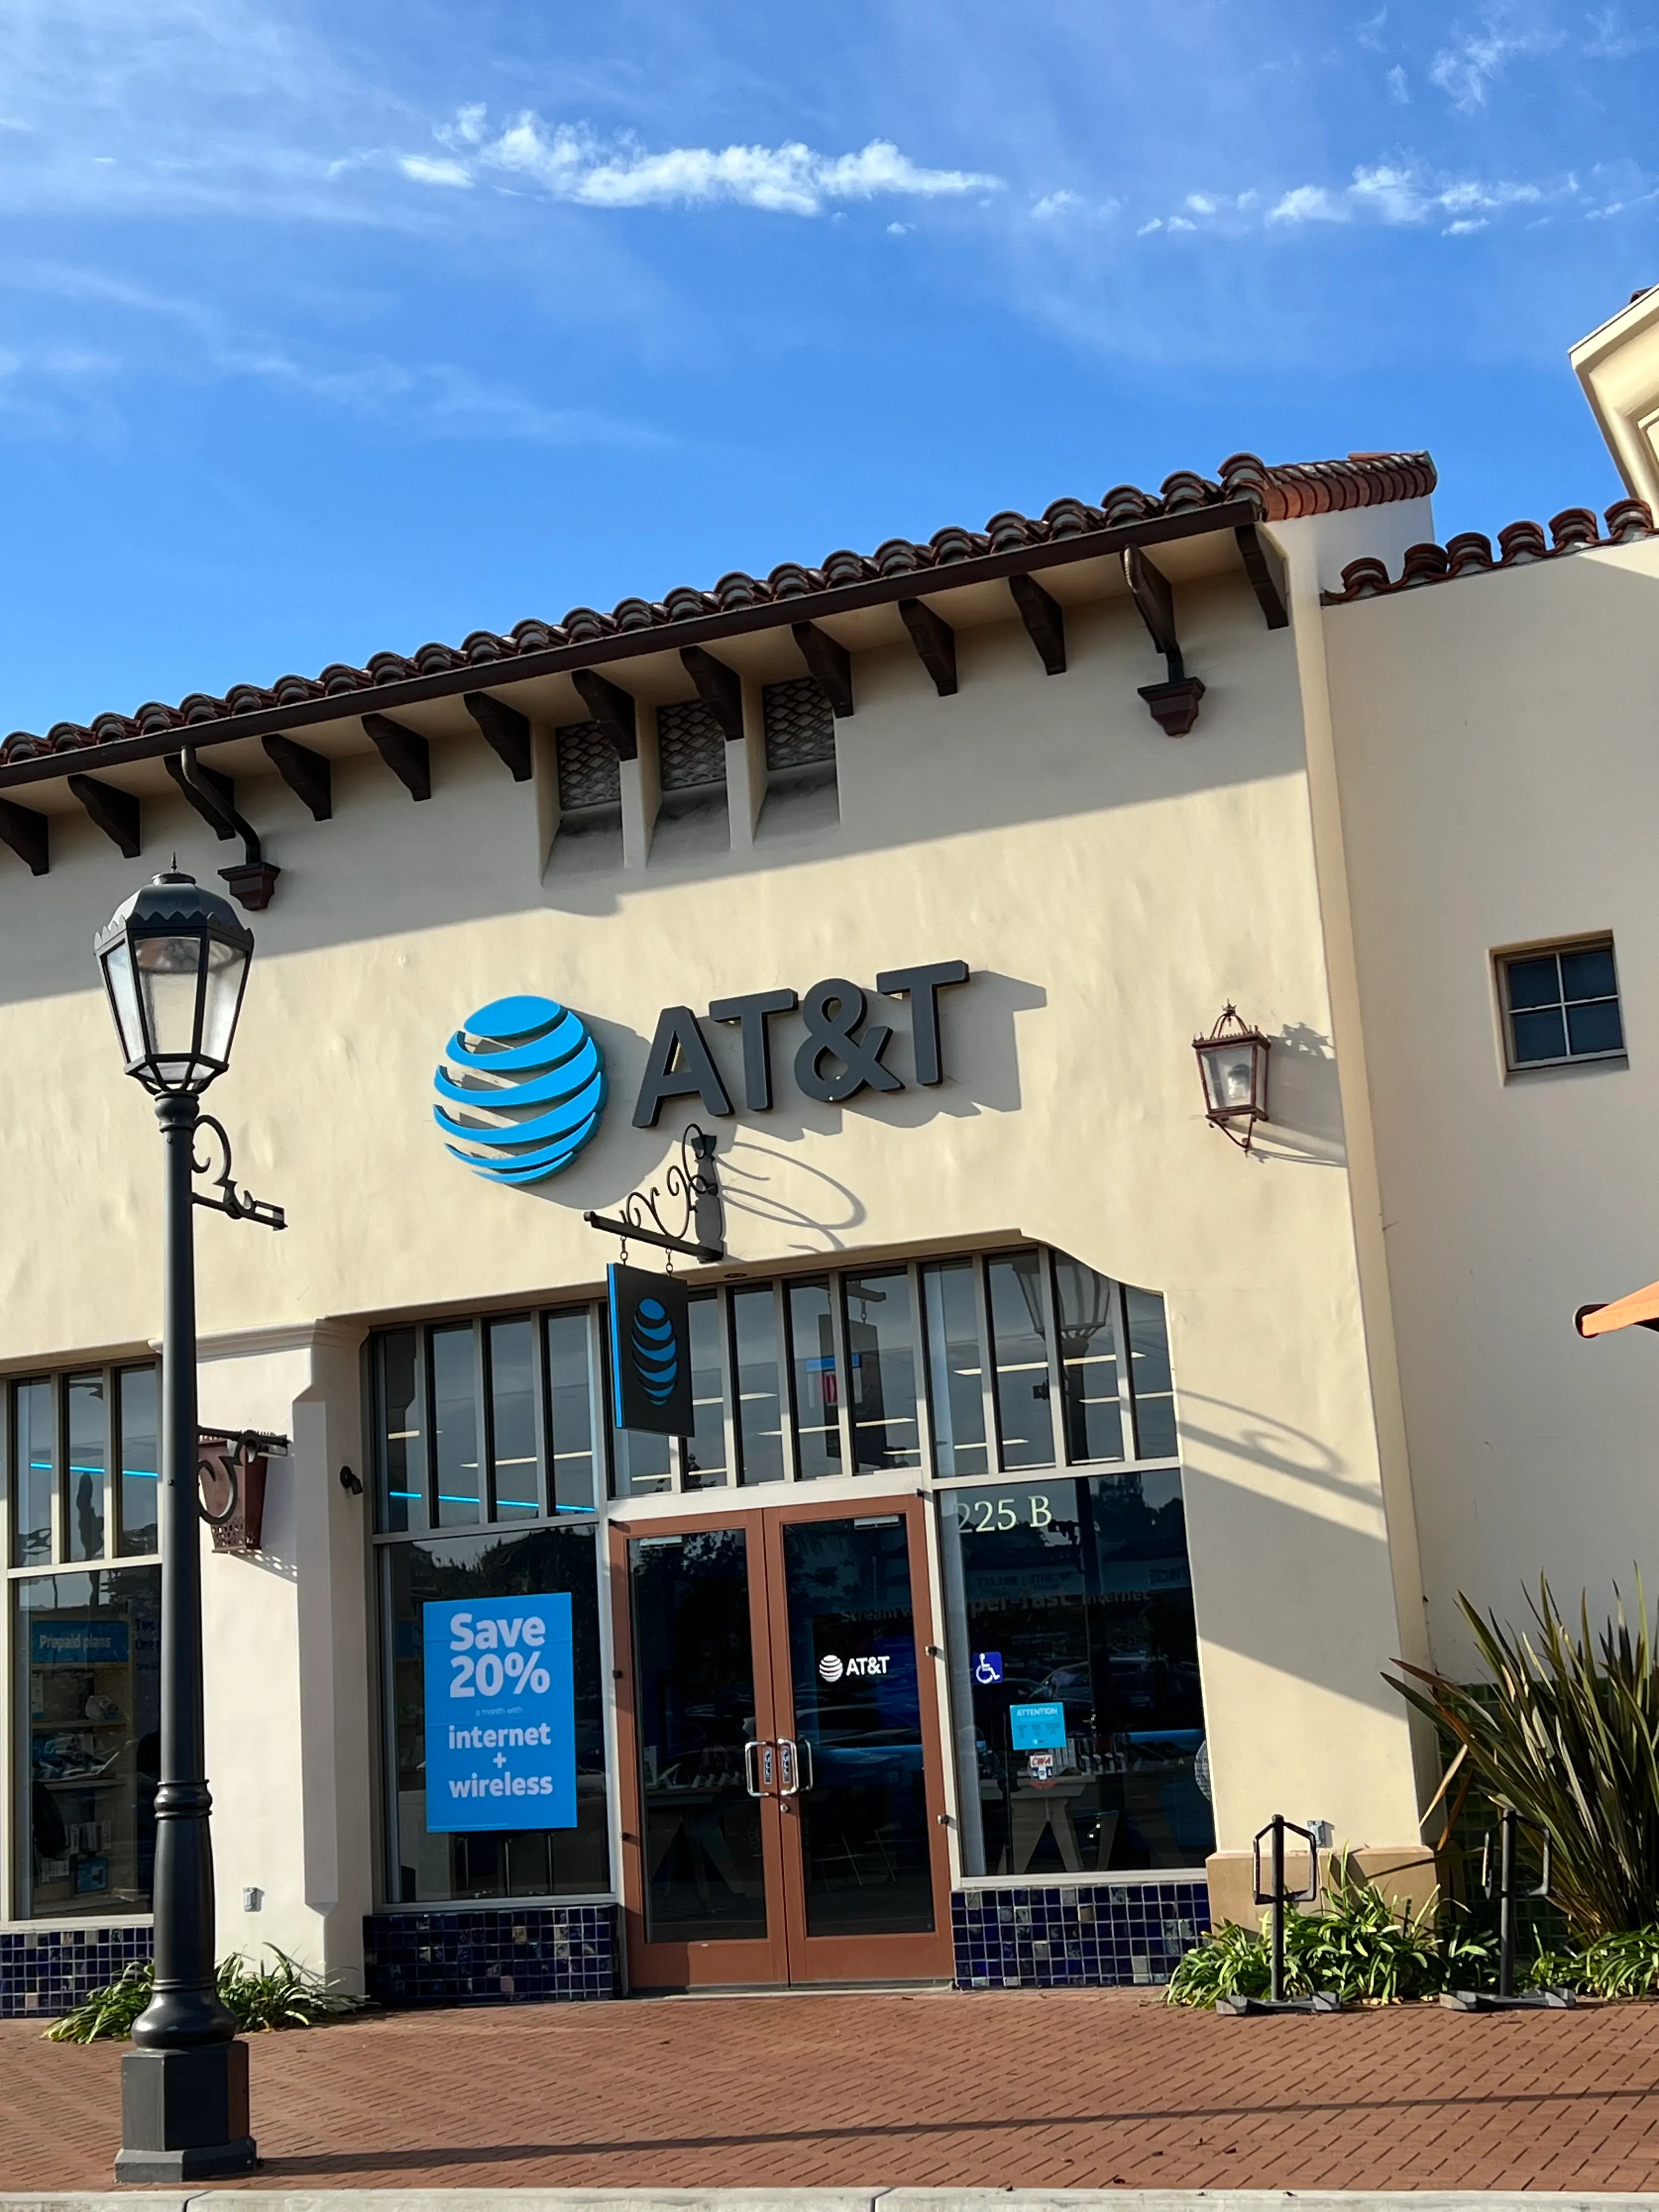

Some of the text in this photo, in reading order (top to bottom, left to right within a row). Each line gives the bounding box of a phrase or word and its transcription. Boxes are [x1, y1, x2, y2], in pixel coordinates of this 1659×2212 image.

[632, 960, 969, 1128] AT&T
[956, 1496, 1052, 1532] 225 B
[39, 1633, 111, 1652] Prepaid plans
[450, 1612, 545, 1651] Save
[449, 1651, 551, 1698] 20%
[846, 1656, 890, 1675] AT&T
[1017, 1708, 1058, 1717] ATTENTION
[448, 1723, 551, 1750] internet
[493, 1752, 507, 1768] +
[1031, 1757, 1052, 1765] CWA
[449, 1771, 553, 1797] wireless
